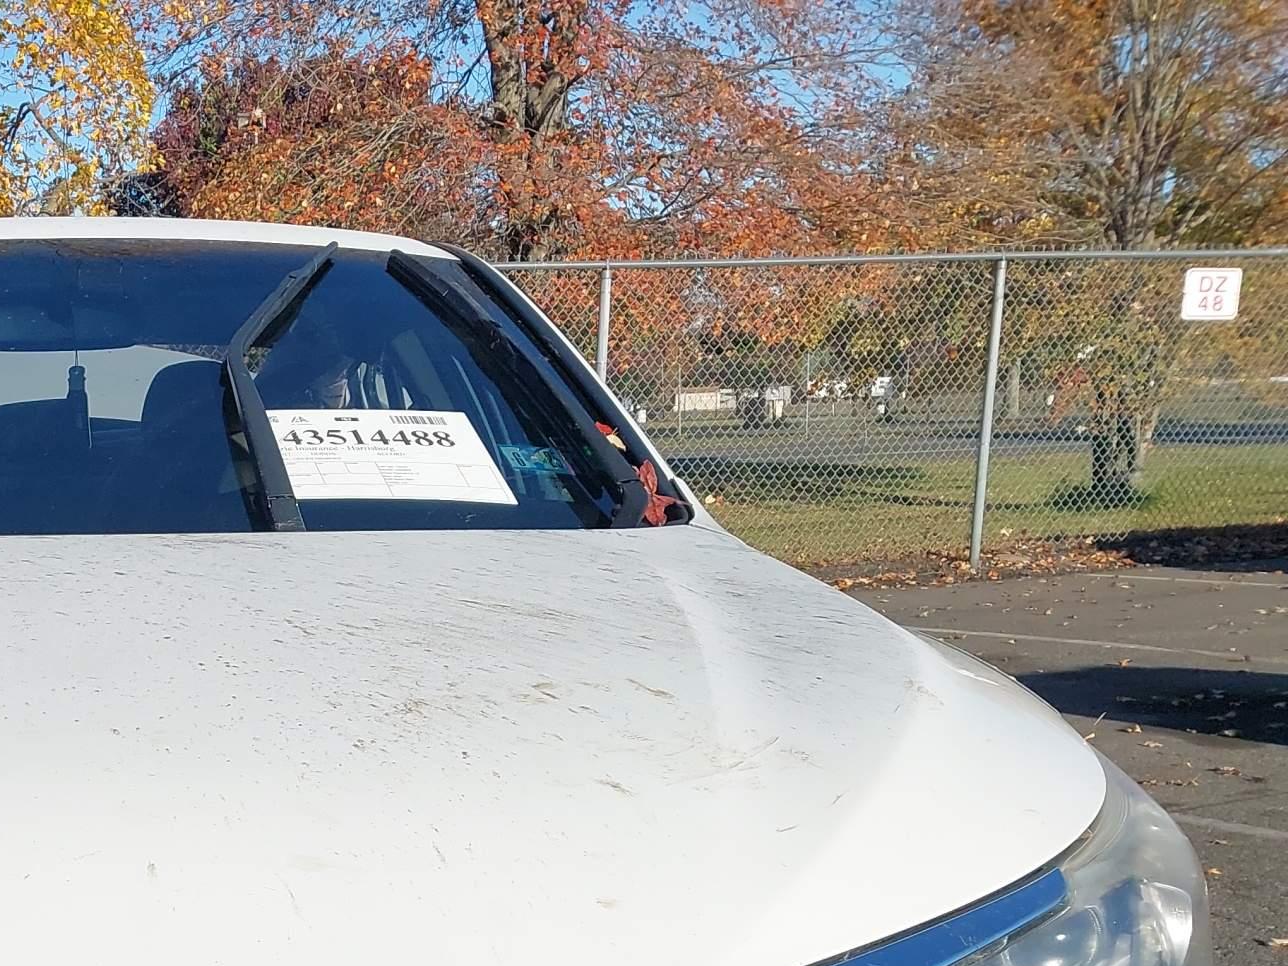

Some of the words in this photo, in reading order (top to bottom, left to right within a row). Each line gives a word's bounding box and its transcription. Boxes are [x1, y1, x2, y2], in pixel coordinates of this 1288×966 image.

[1199, 276, 1228, 292] DZ
[1198, 295, 1223, 311] 48
[283, 429, 456, 447] 43514488
